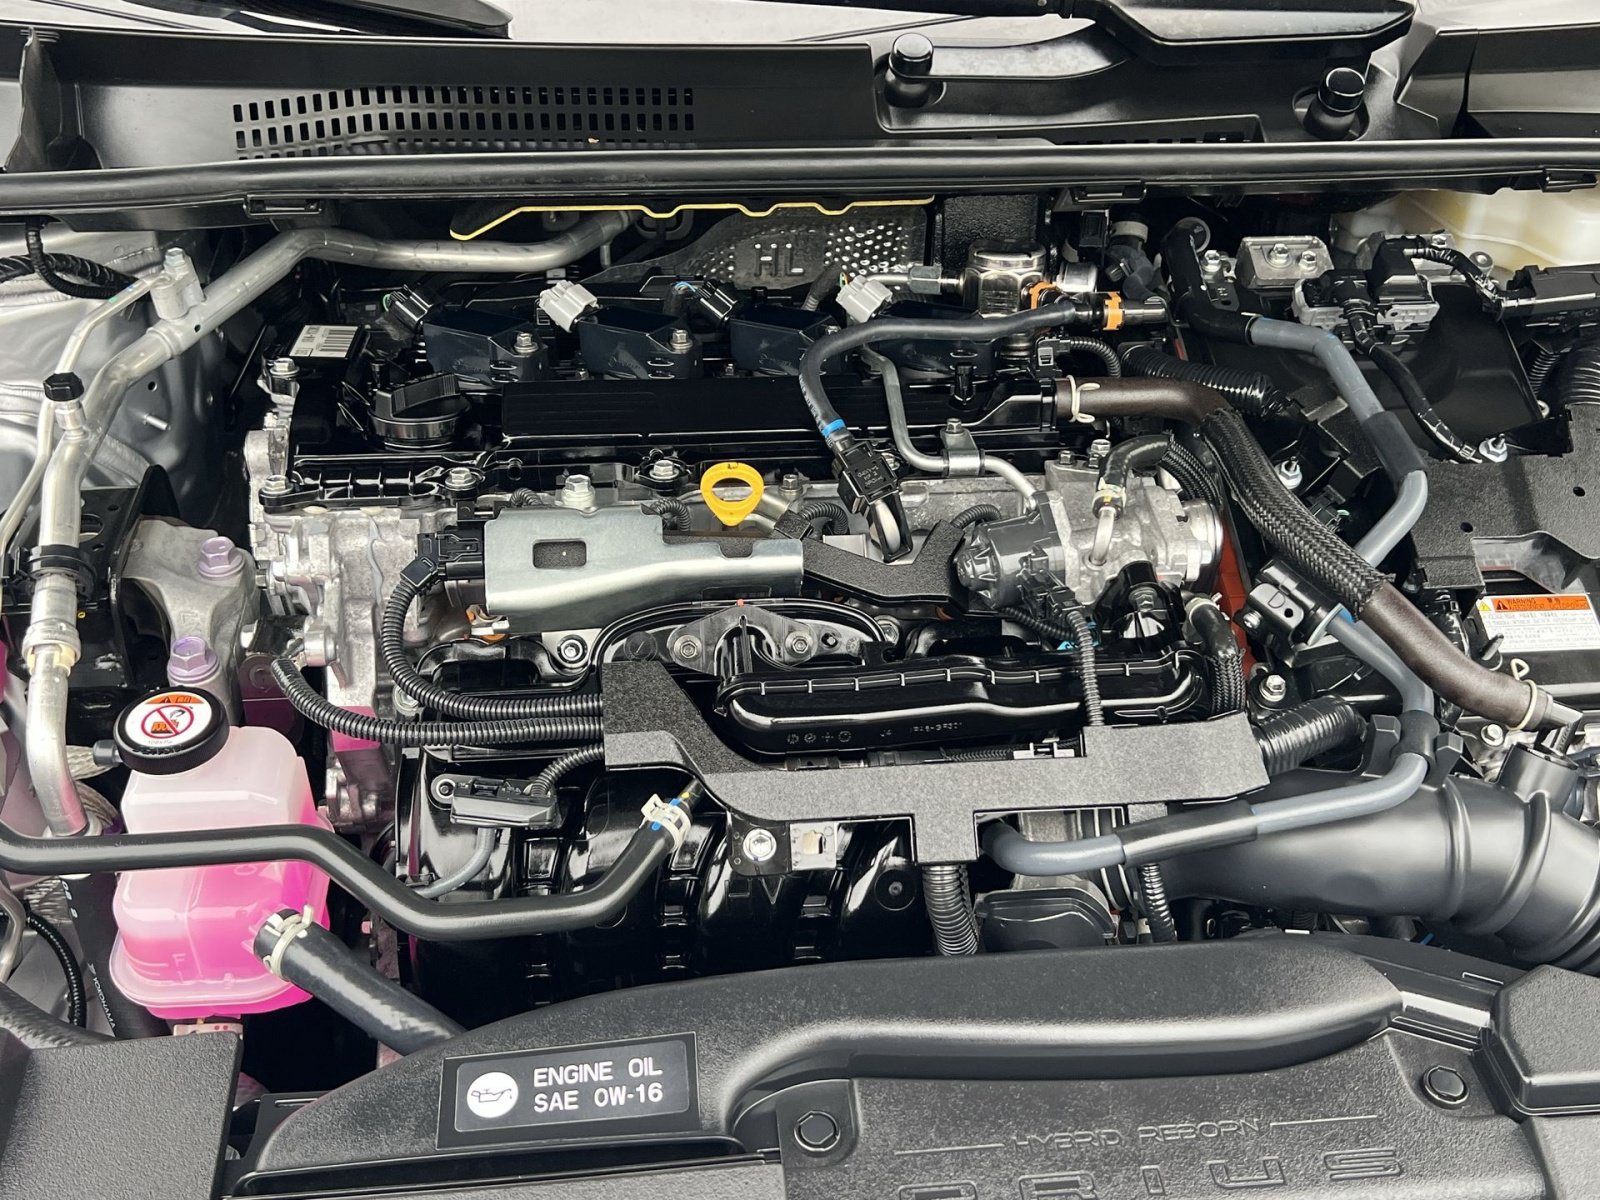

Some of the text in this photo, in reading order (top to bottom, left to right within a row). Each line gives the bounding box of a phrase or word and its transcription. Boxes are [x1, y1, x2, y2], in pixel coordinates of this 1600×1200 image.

[93, 977, 116, 1030] YOKOHAMA
[533, 1056, 663, 1088] ENGINE OIL
[533, 1082, 663, 1113] SAE 0W-16
[1013, 1117, 1260, 1155] HYBRID REBORN
